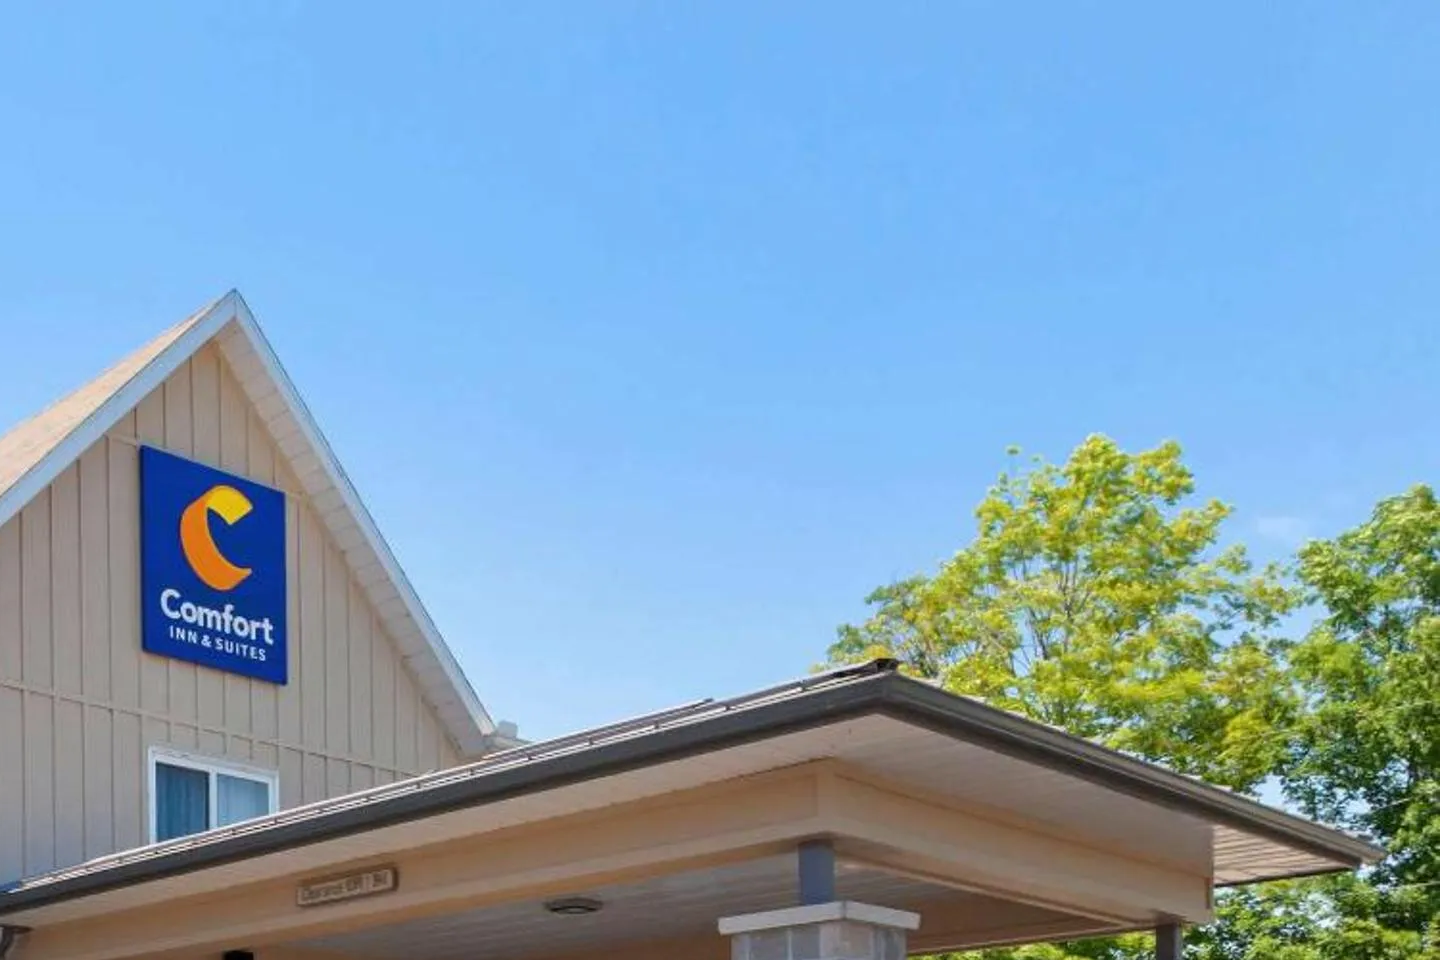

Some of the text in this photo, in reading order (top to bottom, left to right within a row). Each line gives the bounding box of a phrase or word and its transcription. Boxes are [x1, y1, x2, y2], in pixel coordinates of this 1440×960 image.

[160, 588, 274, 645] Comfort
[169, 625, 267, 662] INN & SUITES
